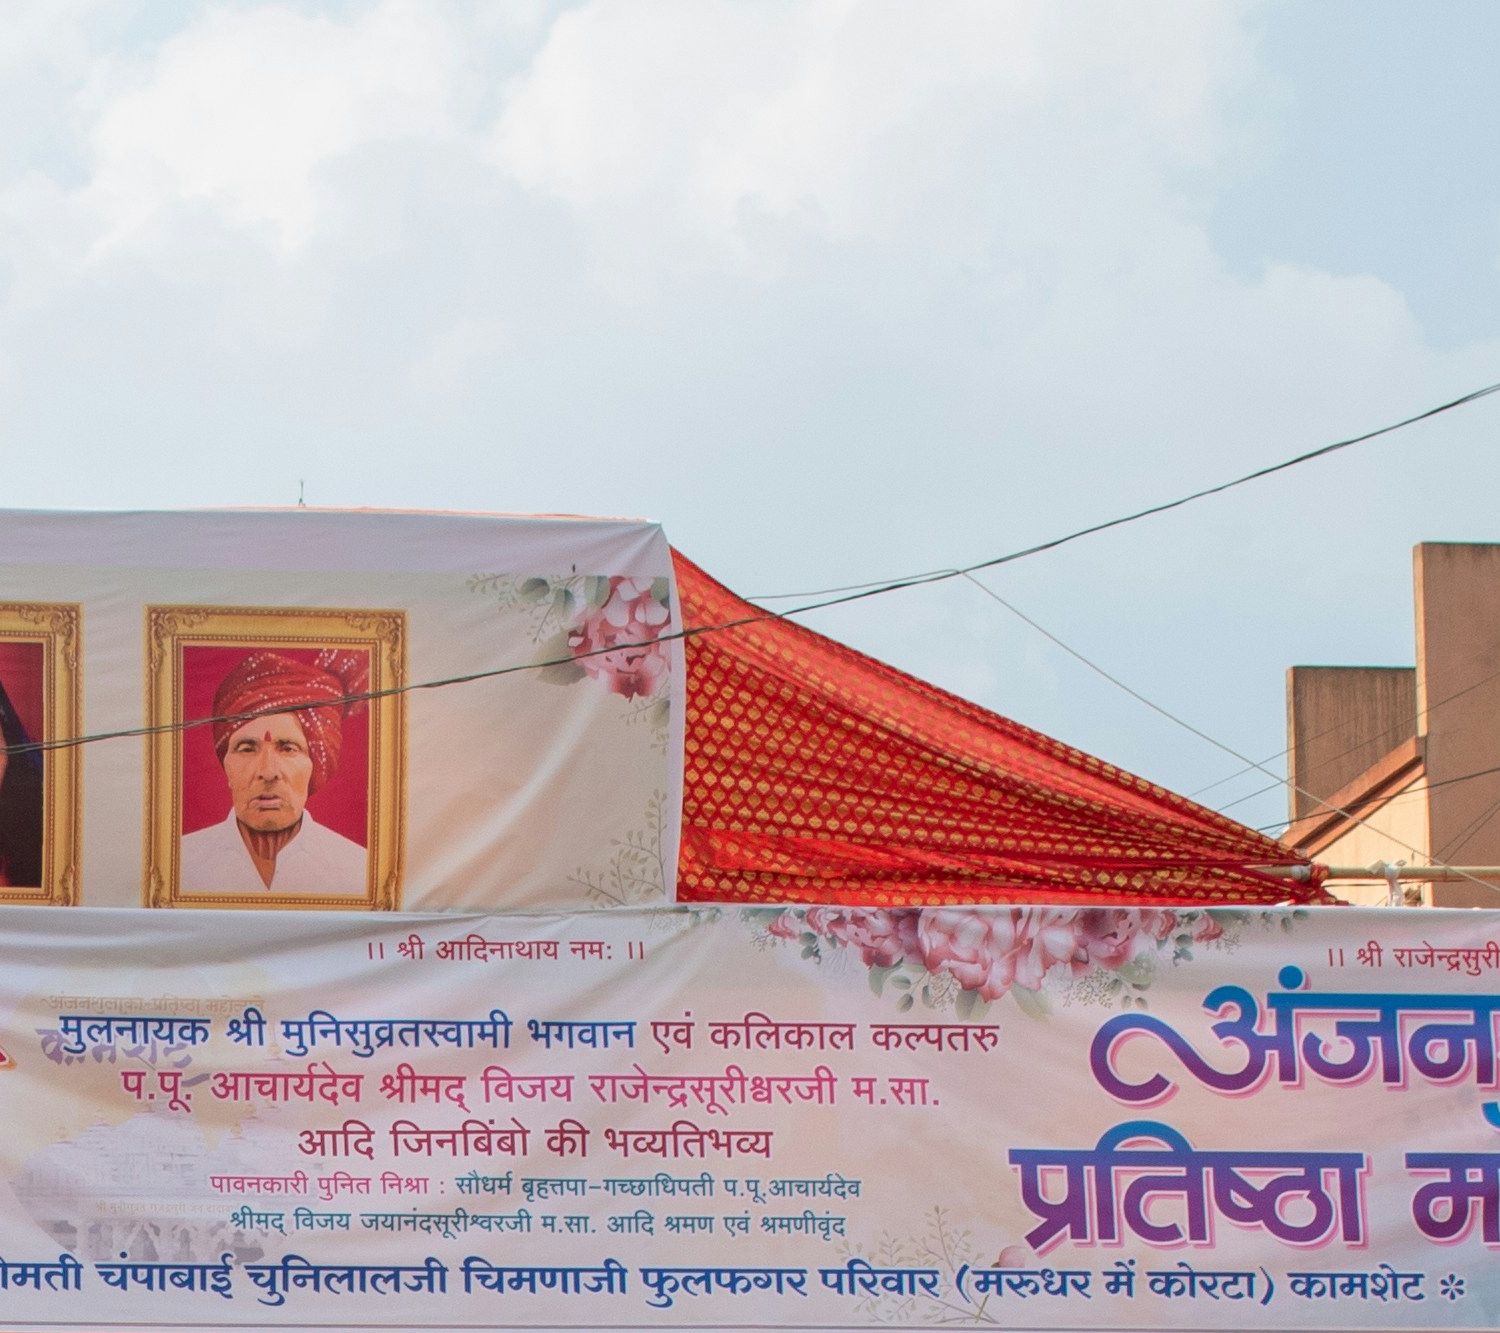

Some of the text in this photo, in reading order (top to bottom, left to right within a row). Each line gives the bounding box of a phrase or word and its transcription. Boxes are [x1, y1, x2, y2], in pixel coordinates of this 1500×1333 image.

[397, 936, 562, 964] श्री आदिनाथाय
[1355, 947, 1384, 970] श्री
[59, 1008, 1000, 1056] मुलनायक श्री भगवान एवं कलिकाल कल्पतरु
[211, 1065, 938, 1110] आचार्यदेव श्रीमद् विजय म.सा.
[298, 1120, 592, 1159] आदि की
[1009, 1120, 1368, 1254] प्रतिष्ठा
[294, 1208, 751, 1237] विजय आदि एवं
[94, 1256, 238, 1301] चंपाबाई
[245, 1256, 448, 1310] चुनिलालजी
[459, 1258, 626, 1299] चिमणाजी
[819, 1262, 938, 1301] परिवार
[1104, 1261, 1138, 1303] में
[1147, 1265, 1274, 1307] कोरटा)
[1289, 1265, 1426, 1304] कामशेट
